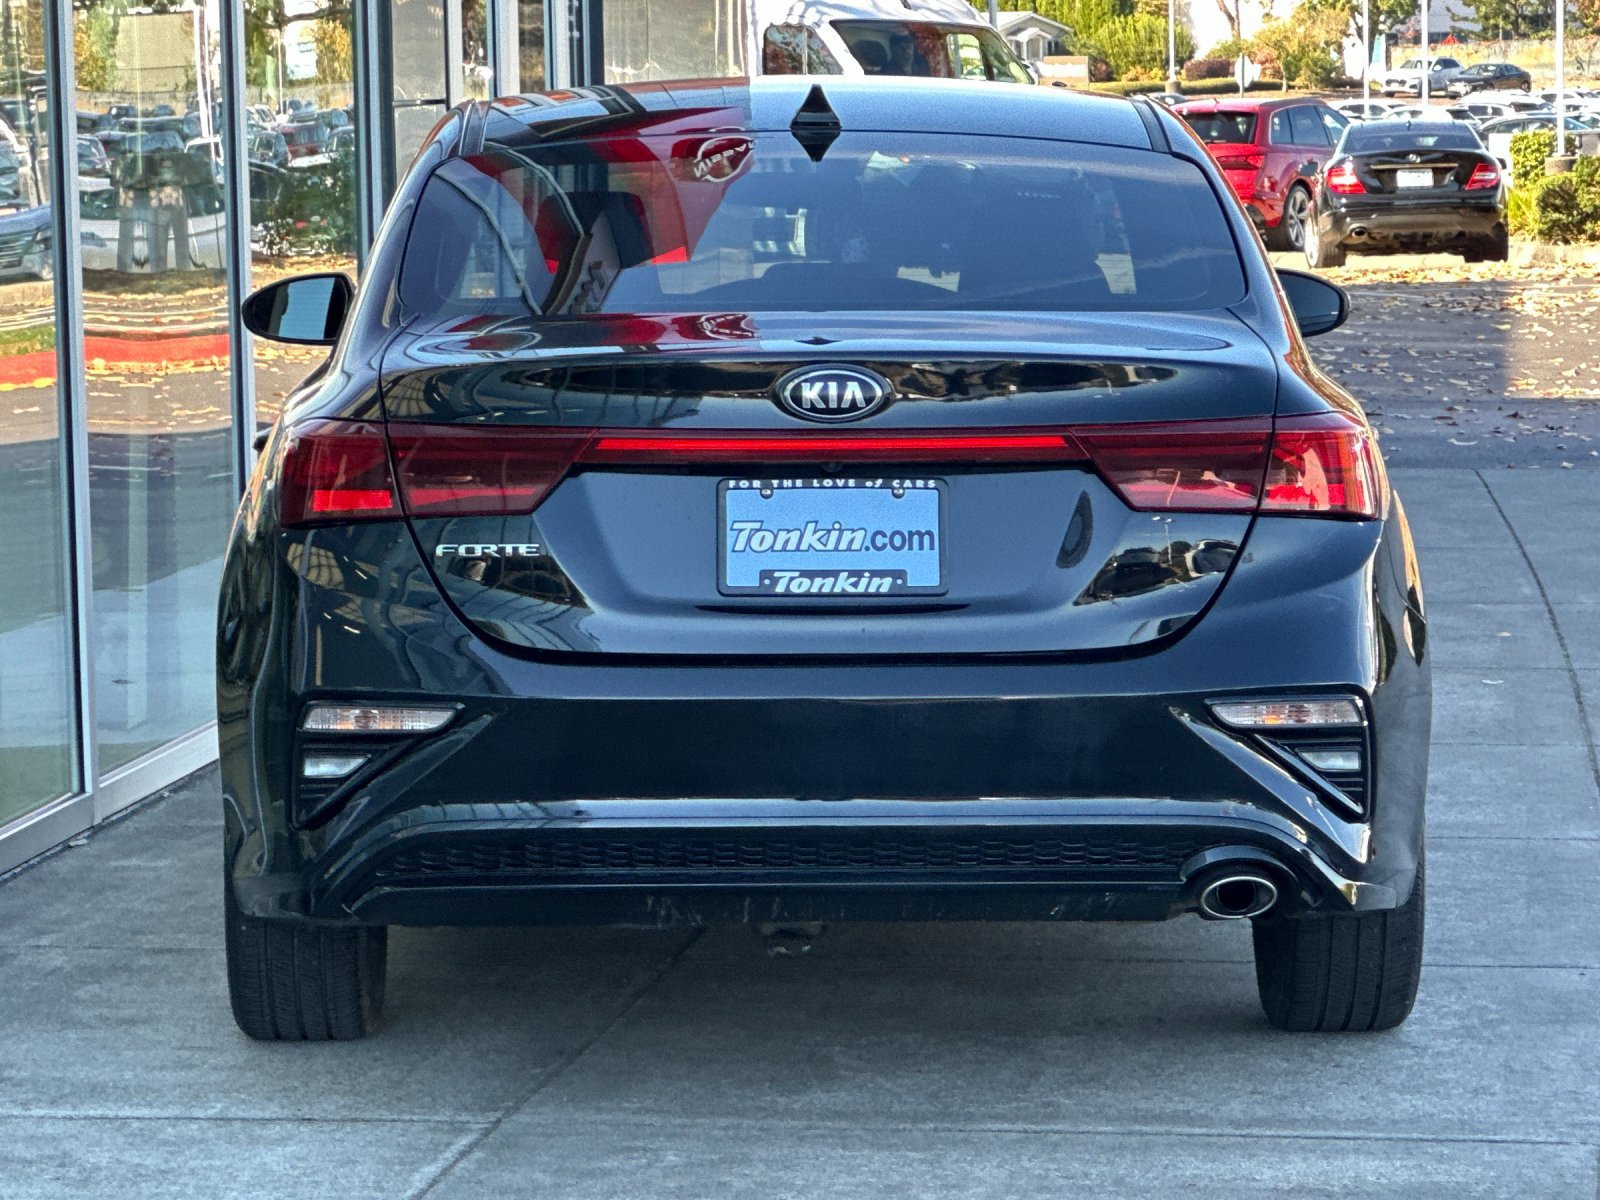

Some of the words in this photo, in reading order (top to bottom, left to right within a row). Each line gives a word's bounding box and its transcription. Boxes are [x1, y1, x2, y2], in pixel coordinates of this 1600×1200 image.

[801, 381, 866, 408] KIA
[729, 479, 761, 488] FOR
[772, 479, 803, 488] THE
[813, 479, 856, 487] LOVE
[892, 479, 936, 488] CARS
[730, 520, 935, 552] Tonkin.com
[436, 544, 540, 557] FORTE
[773, 572, 892, 593] Tonkin
